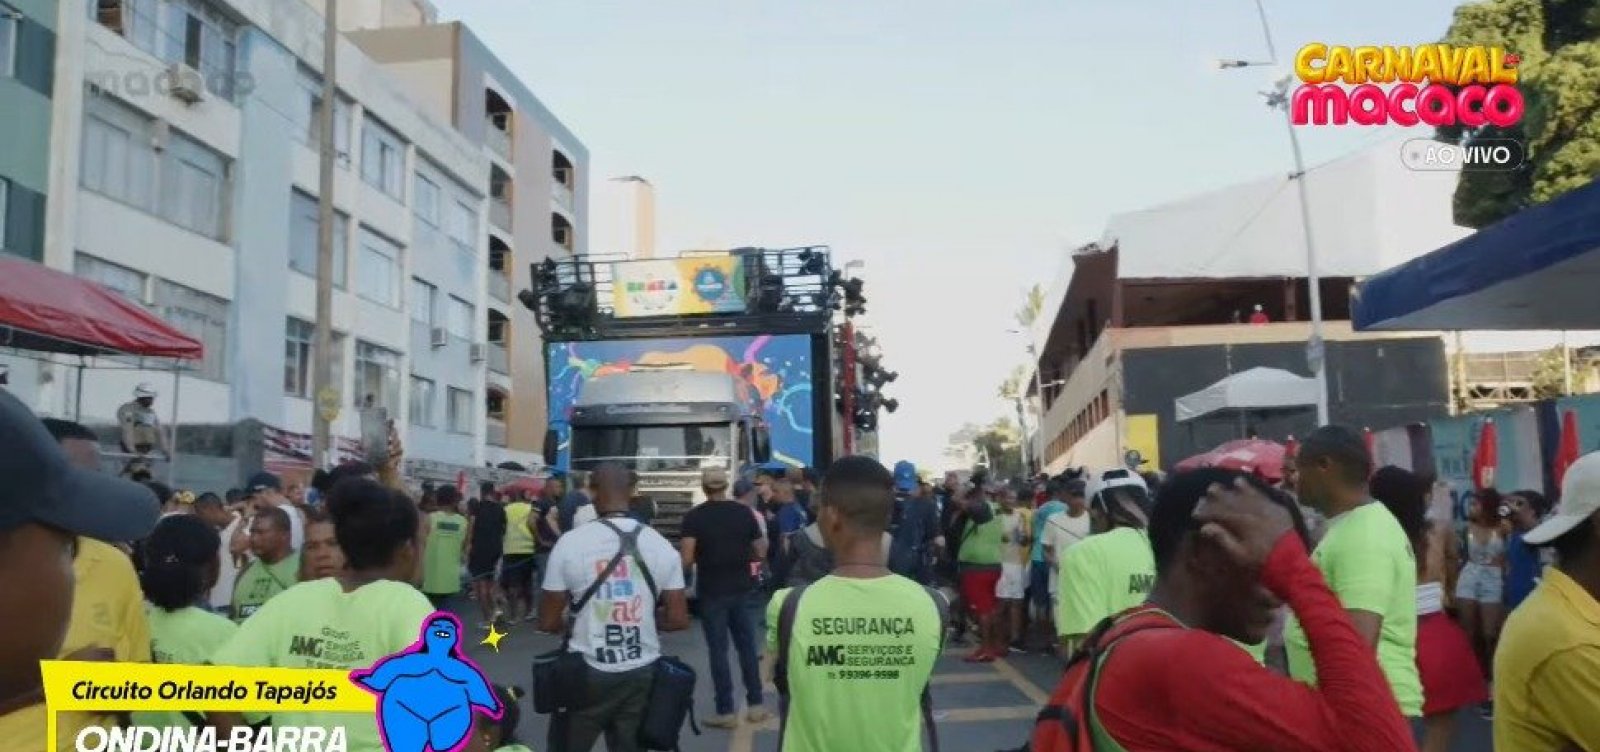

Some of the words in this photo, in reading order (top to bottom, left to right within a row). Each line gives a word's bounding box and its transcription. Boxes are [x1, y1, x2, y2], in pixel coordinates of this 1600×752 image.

[812, 617, 915, 639] SEGURANÇA
[806, 645, 845, 667] AMG
[847, 645, 903, 657] SERVIÇOS
